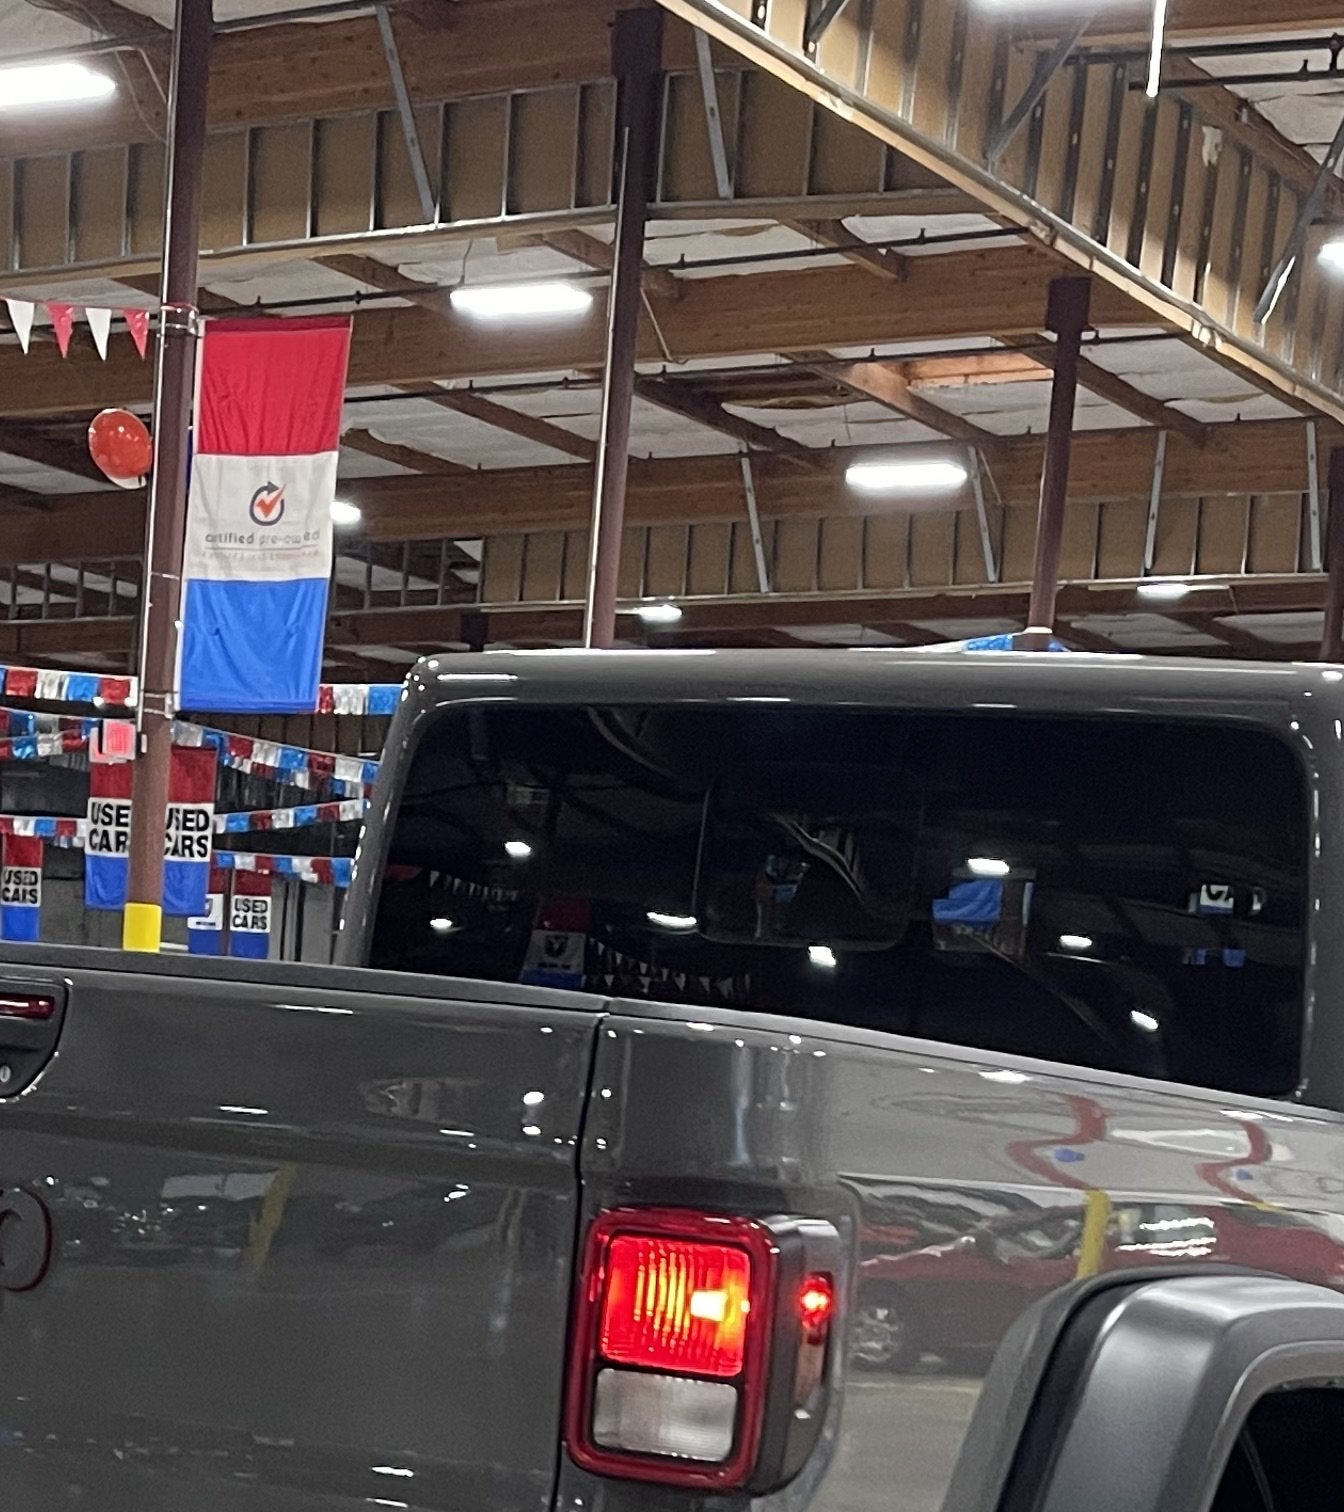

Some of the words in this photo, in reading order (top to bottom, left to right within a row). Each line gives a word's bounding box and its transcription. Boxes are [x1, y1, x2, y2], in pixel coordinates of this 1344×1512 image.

[91, 803, 131, 828] USE
[89, 828, 129, 853] CAR
[234, 898, 268, 914] USED
[232, 914, 268, 930] CARS
